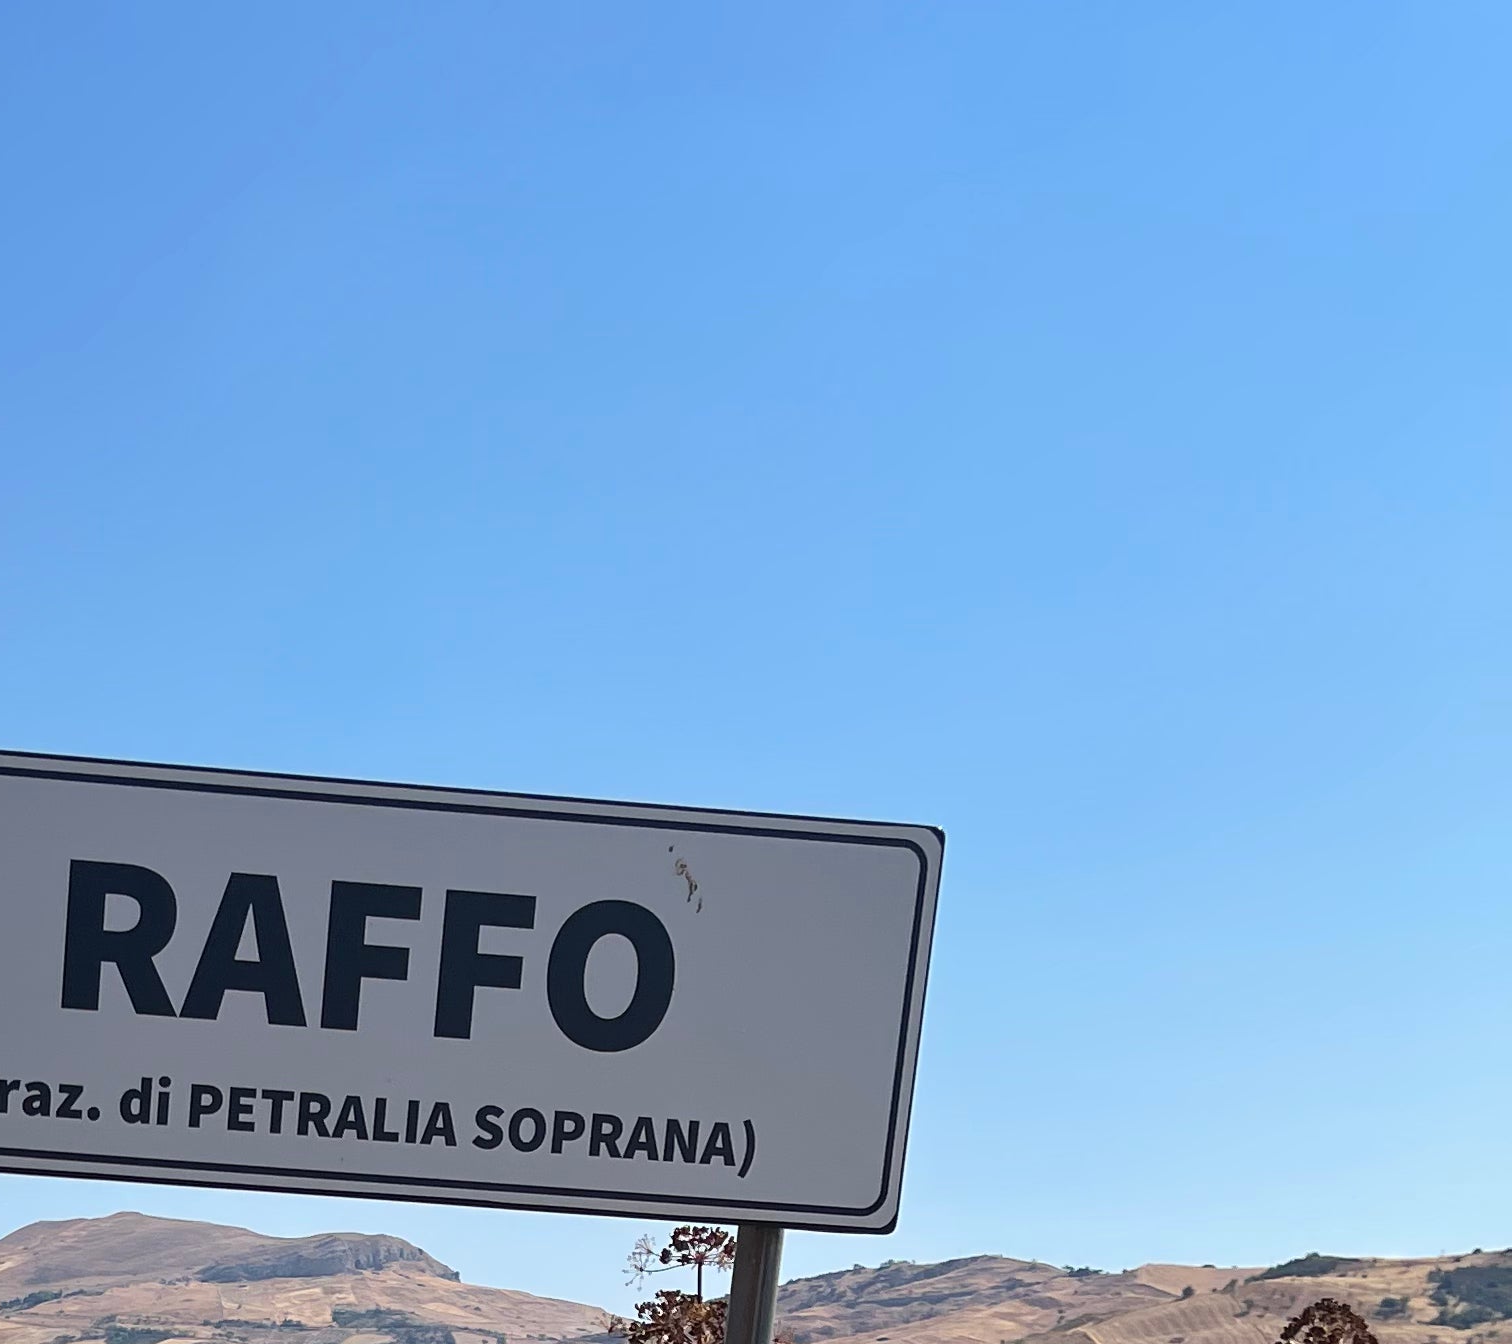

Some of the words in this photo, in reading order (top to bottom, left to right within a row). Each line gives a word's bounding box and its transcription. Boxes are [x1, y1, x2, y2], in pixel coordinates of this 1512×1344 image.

[60, 858, 676, 1053] RAFFO
[119, 1075, 172, 1126] di
[188, 1083, 457, 1147] PETRALIA
[471, 1104, 756, 1179] SOPRANA)
